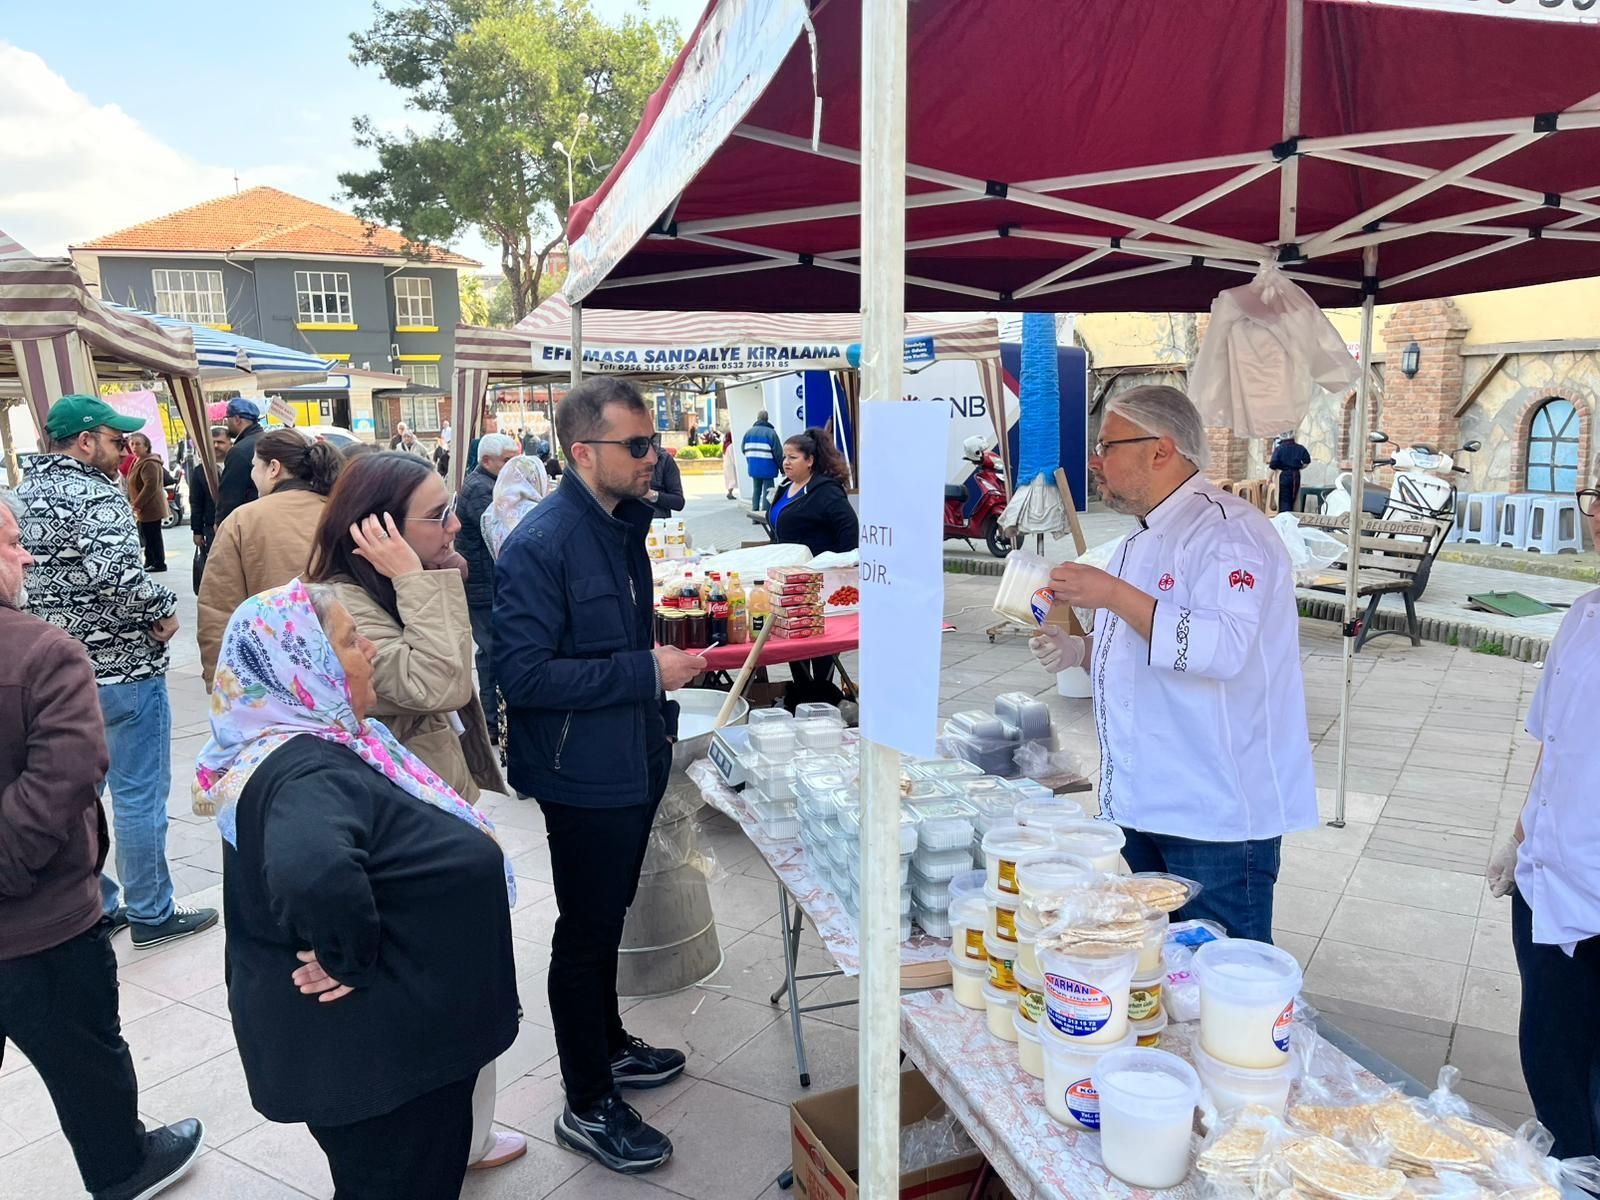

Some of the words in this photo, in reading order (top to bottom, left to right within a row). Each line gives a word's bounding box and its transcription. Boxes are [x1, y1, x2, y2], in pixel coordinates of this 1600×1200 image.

[582, 350, 638, 363] MASA
[643, 347, 740, 363] SANDALYE
[698, 362, 719, 370] Gsm:
[721, 361, 743, 369] 0532
[930, 396, 986, 419] NB
[1050, 976, 1090, 996] TARHAN
